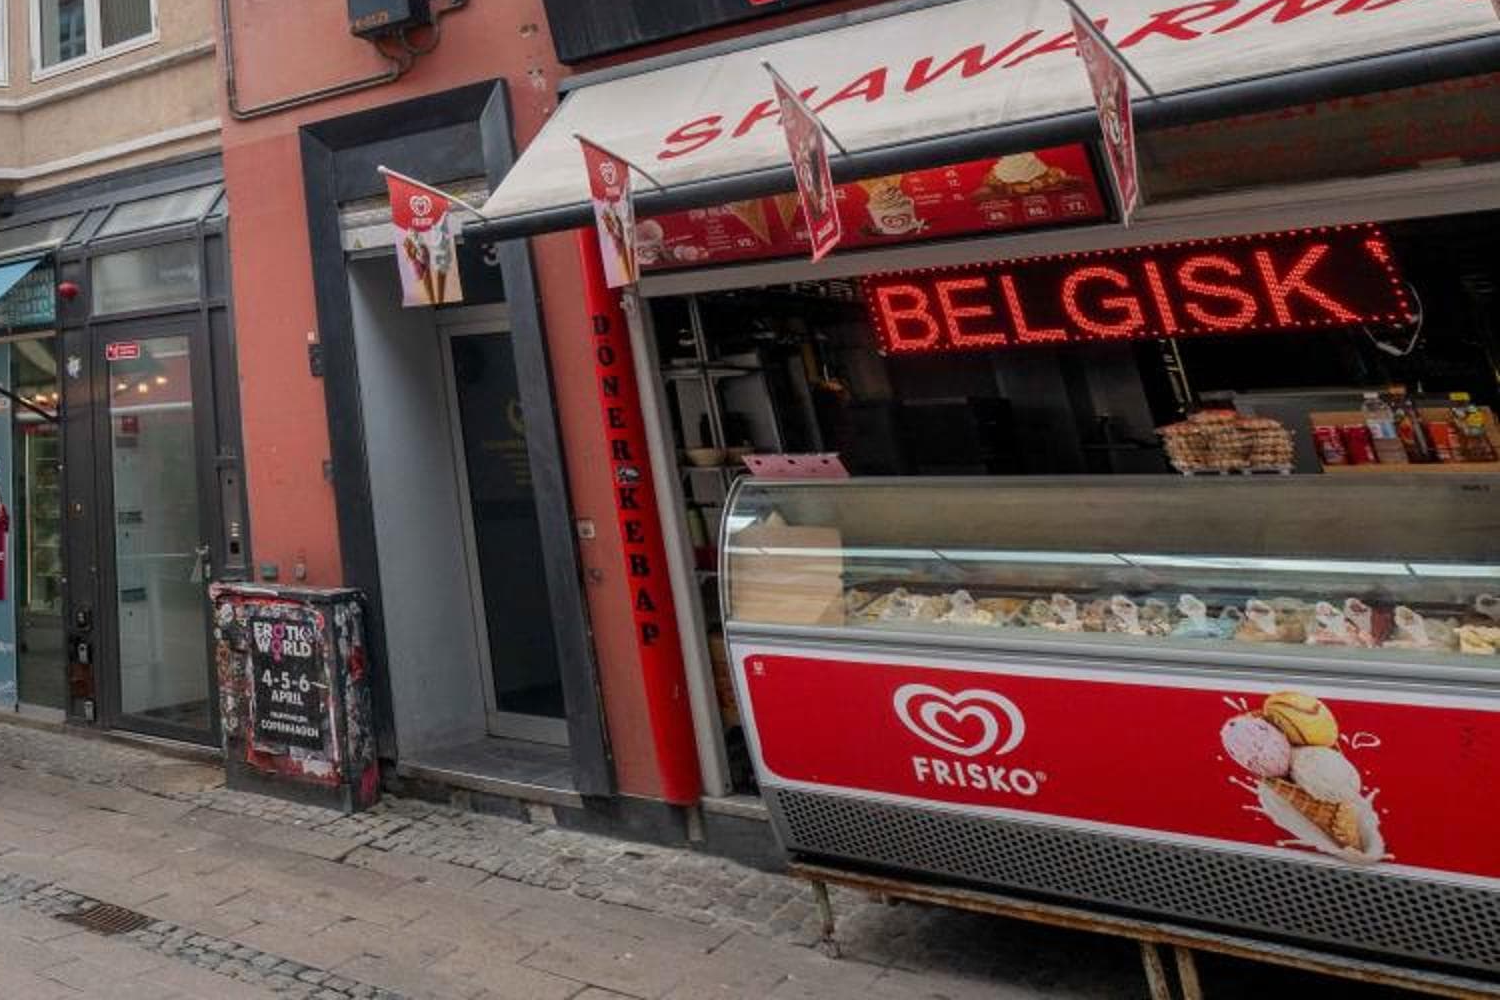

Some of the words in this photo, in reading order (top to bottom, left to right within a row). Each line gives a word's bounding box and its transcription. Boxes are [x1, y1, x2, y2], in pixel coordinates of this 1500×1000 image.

[876, 244, 1358, 351] BELGISK
[619, 487, 660, 647] KEBAP
[255, 636, 312, 660] WORLD
[261, 669, 311, 693] 4-5-6
[271, 689, 305, 707] APRIL
[260, 718, 320, 739] COPENHAGEN
